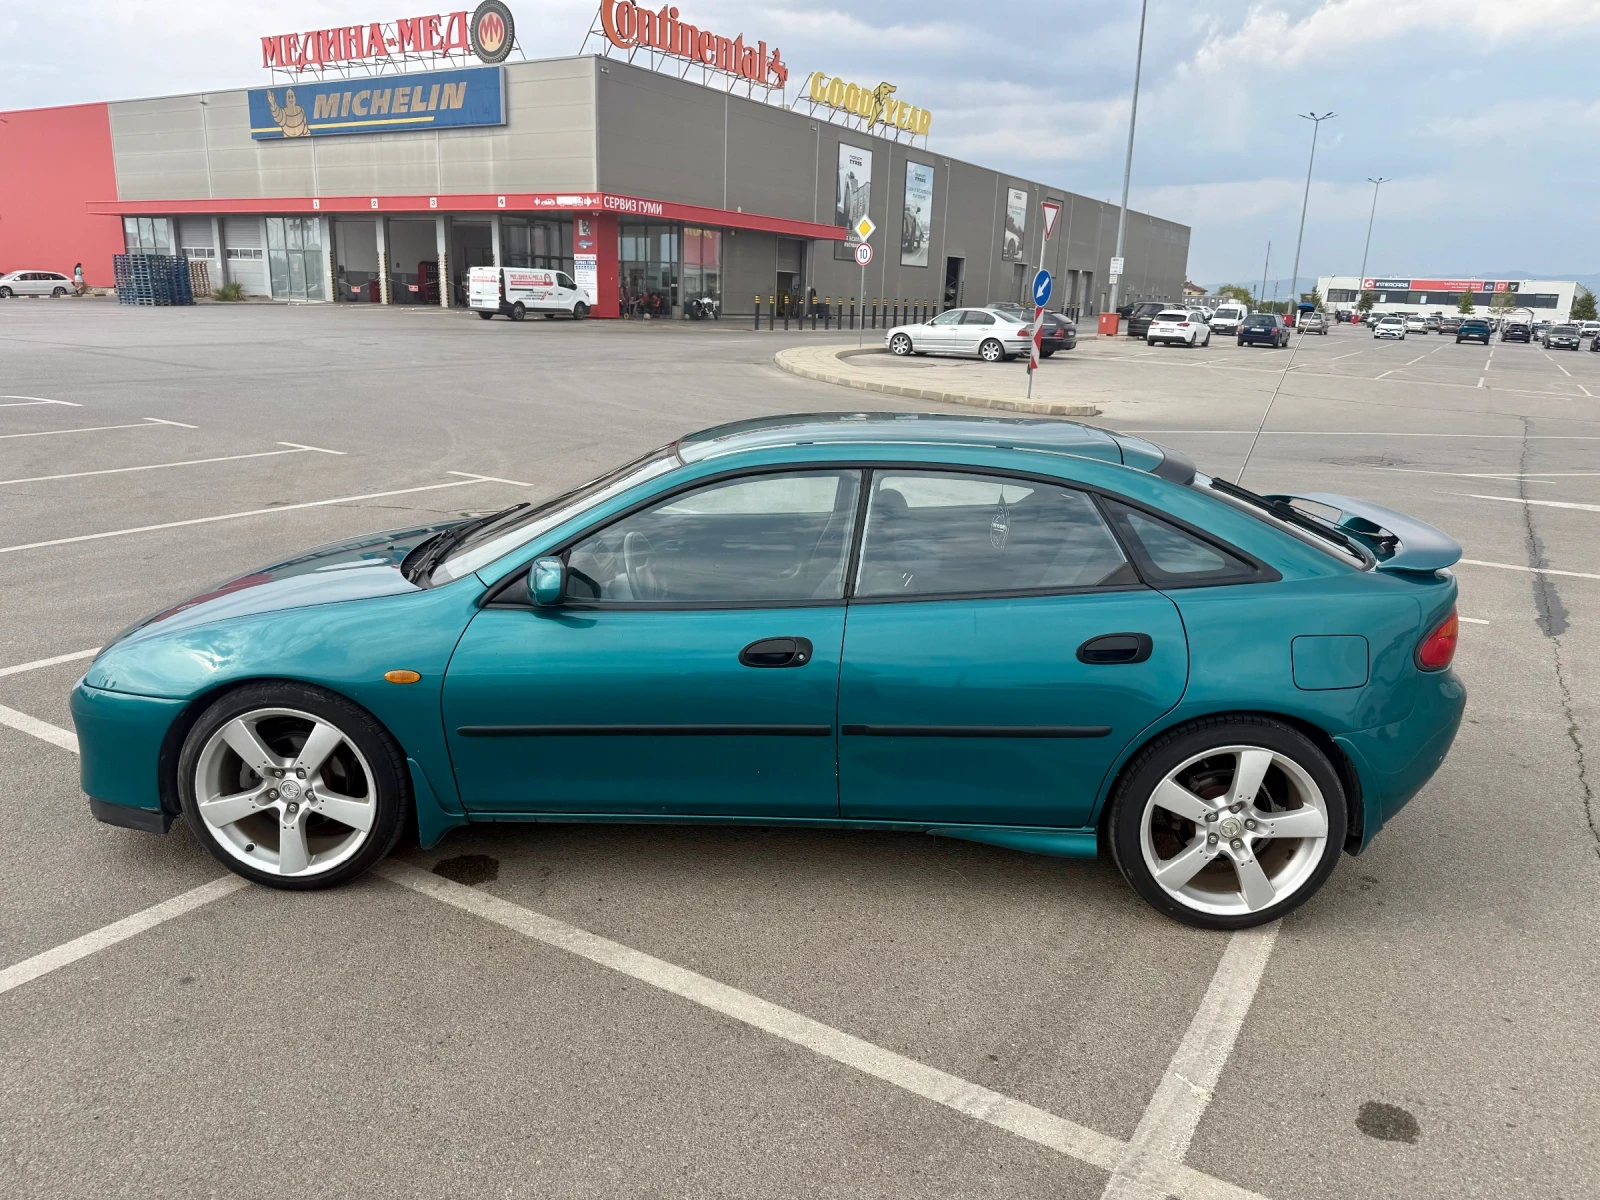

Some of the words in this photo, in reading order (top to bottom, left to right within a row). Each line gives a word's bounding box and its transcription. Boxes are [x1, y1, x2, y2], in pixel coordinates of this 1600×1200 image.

[260, 11, 471, 73] МЕДИНА-МЕД
[601, 0, 767, 83] Continental
[313, 82, 467, 119] MICHELIN
[603, 196, 637, 211] СЕРВИЗ
[638, 201, 663, 215] ГУМИ
[859, 248, 868, 259] 10
